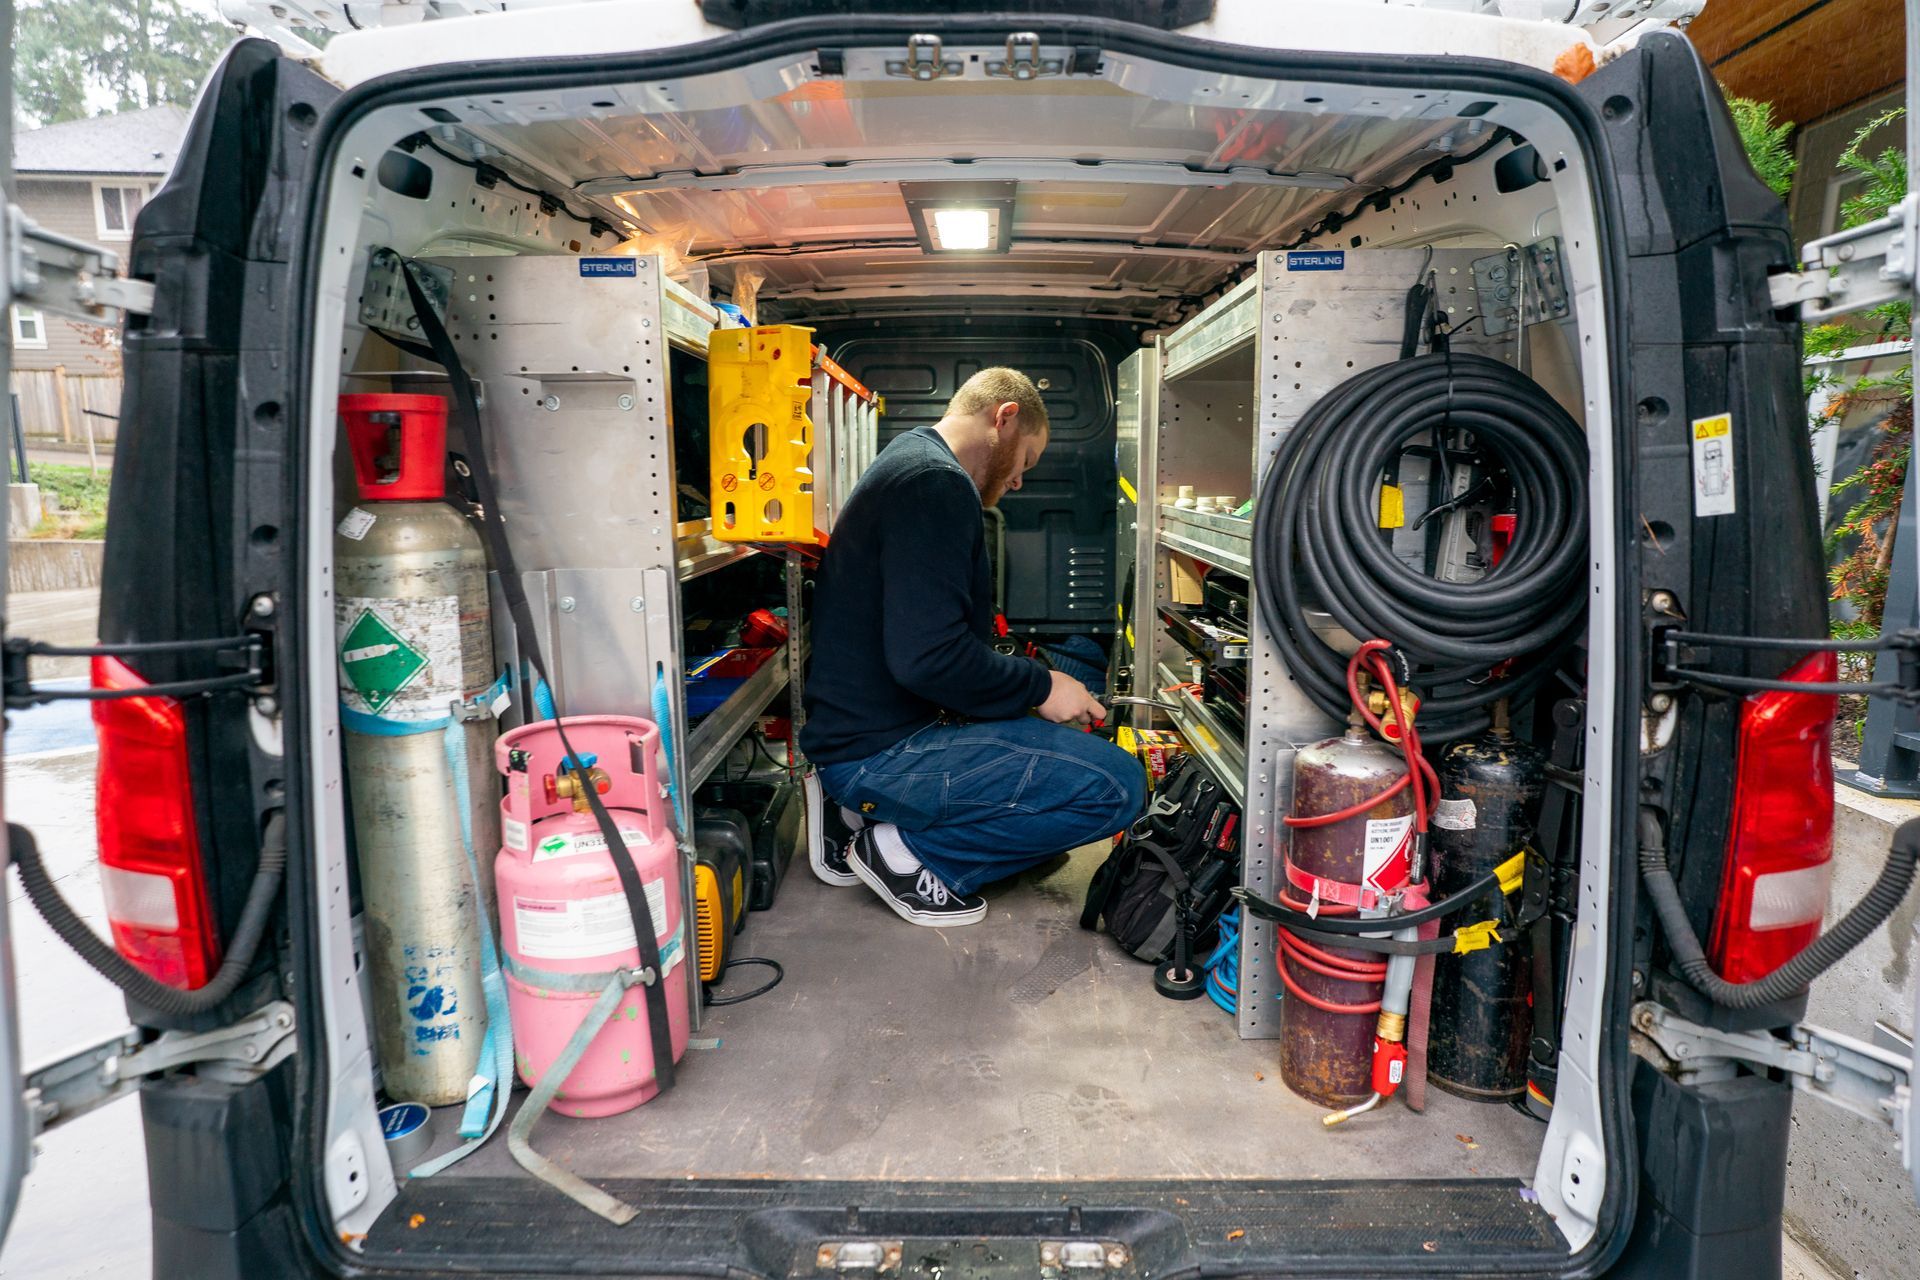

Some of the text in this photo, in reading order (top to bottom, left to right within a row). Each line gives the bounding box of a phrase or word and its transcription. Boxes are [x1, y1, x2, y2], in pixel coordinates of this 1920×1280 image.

[1289, 256, 1343, 266] STERLING
[581, 263, 634, 272] STERLING
[370, 689, 380, 703] 2
